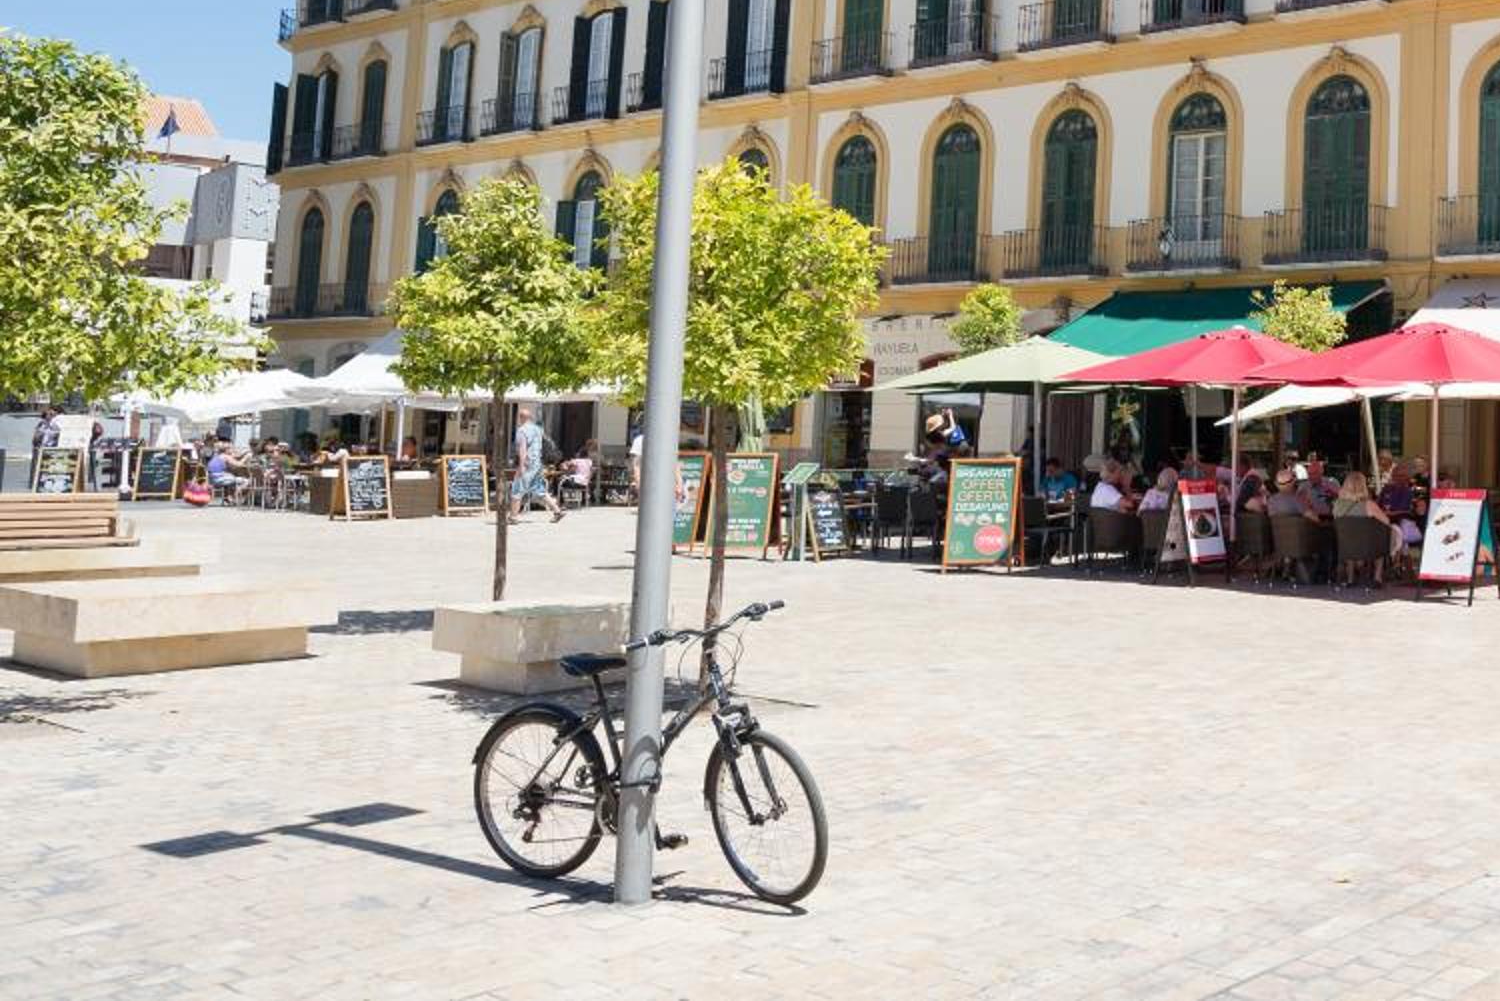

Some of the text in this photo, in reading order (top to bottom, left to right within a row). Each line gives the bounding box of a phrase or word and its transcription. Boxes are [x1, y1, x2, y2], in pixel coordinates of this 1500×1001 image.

[955, 468, 1013, 479] BREAKFAST
[960, 478, 1006, 490] OFFER
[957, 490, 1009, 502] OFERTA
[955, 502, 1009, 512] DESAYUNO
